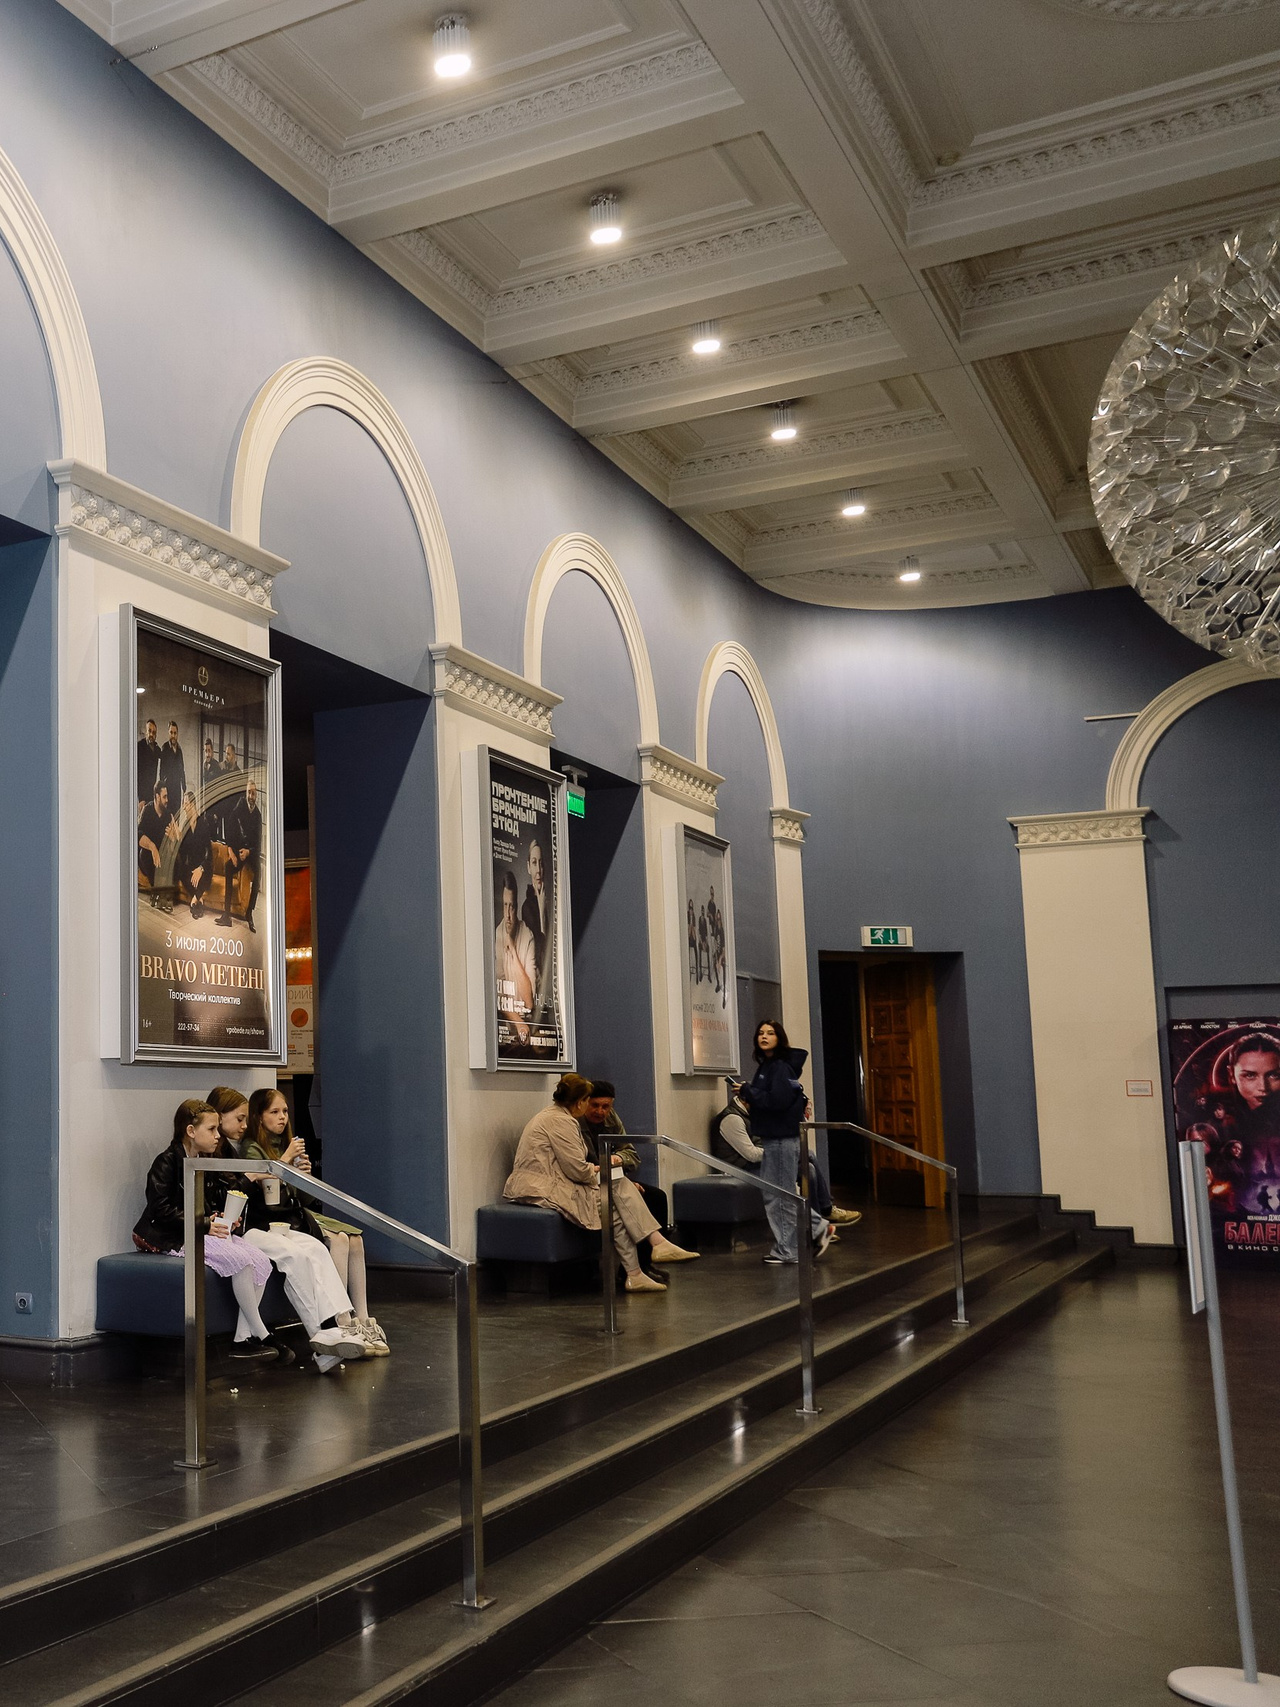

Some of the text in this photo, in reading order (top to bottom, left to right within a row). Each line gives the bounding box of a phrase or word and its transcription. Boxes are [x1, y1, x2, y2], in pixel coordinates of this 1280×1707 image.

[182, 684, 225, 706] ПРЕМЬЕРА
[492, 797, 537, 825] БРАЧНЫЙ
[492, 813, 520, 838] ЭТЮД
[165, 930, 244, 957] 3 июля 20:00
[140, 954, 198, 983] BRAVO
[168, 988, 241, 1006] Творческий коллектив
[1225, 1221, 1280, 1245] БАЛЕ
